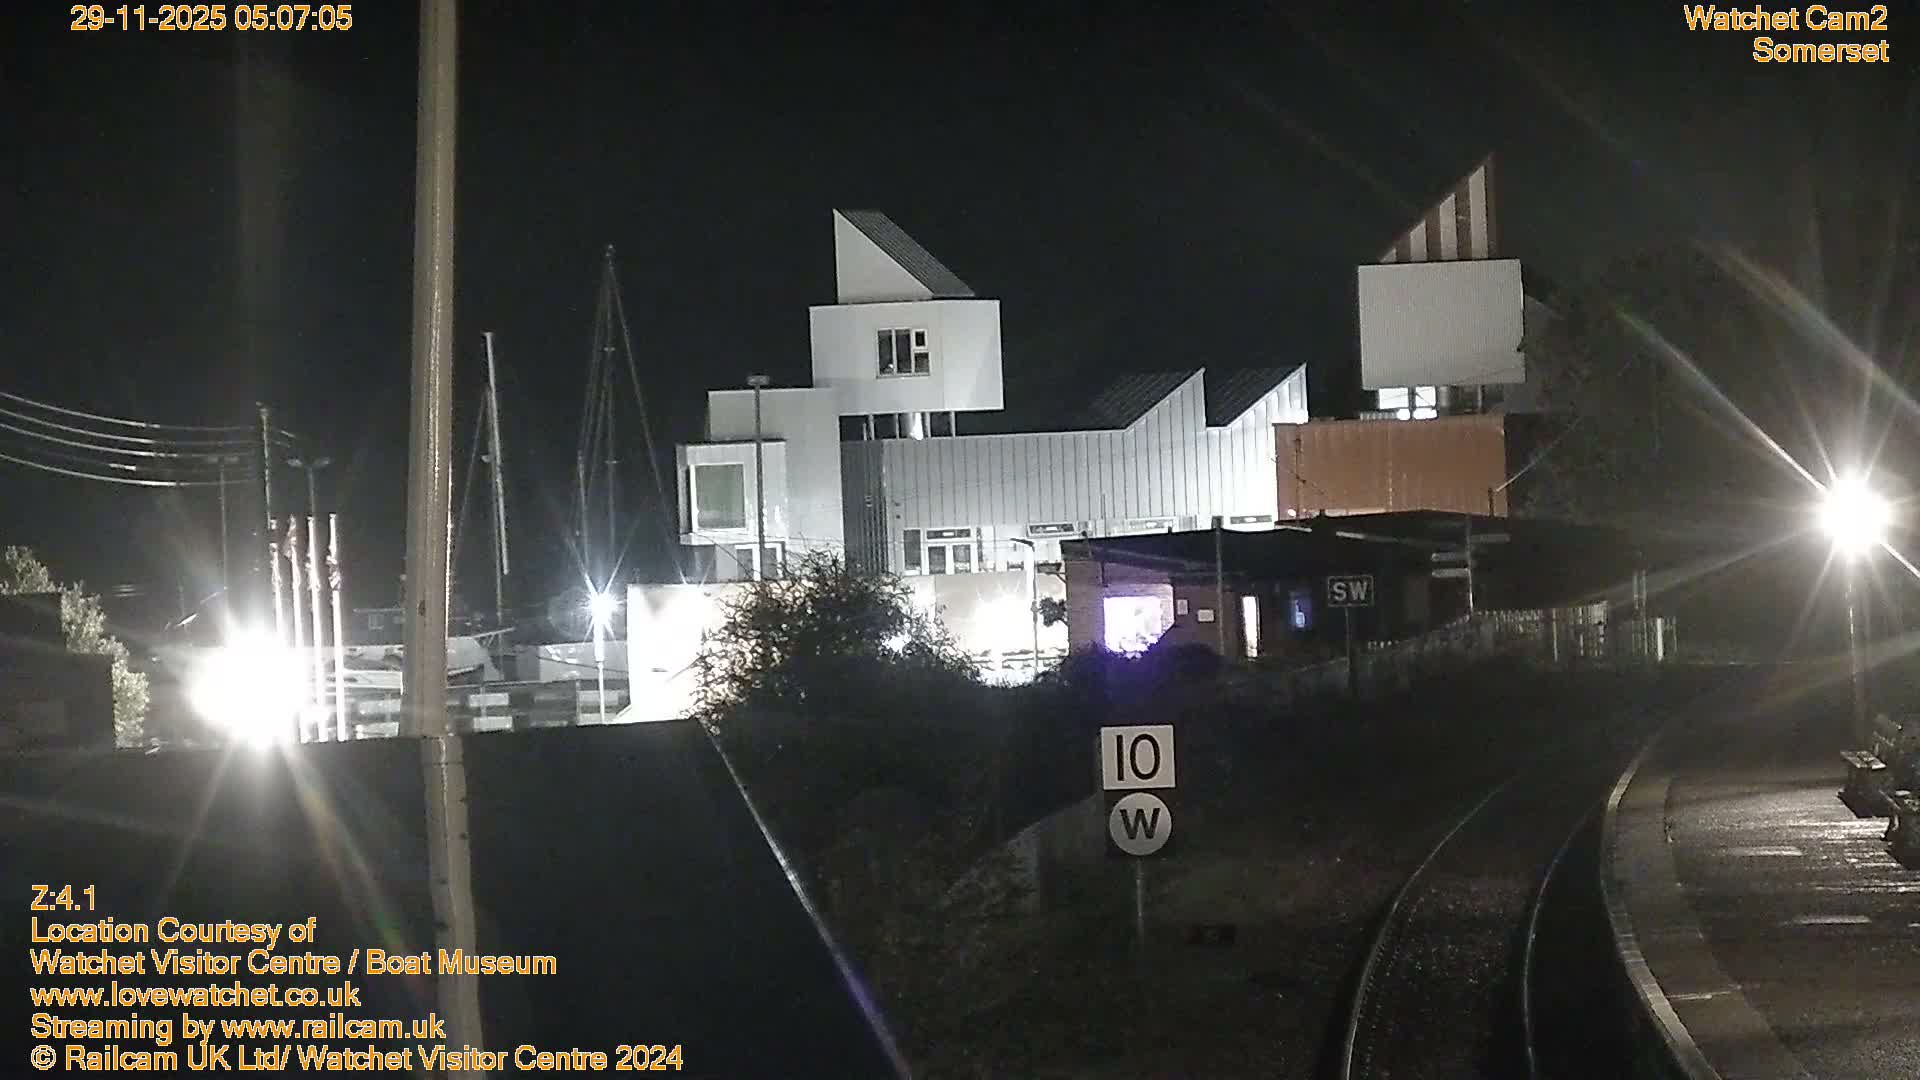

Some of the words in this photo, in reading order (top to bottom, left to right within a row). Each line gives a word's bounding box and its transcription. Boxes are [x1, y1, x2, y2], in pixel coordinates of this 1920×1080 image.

[1333, 581, 1368, 601] SW
[1116, 733, 1161, 782] 10
[1119, 807, 1160, 840] W
